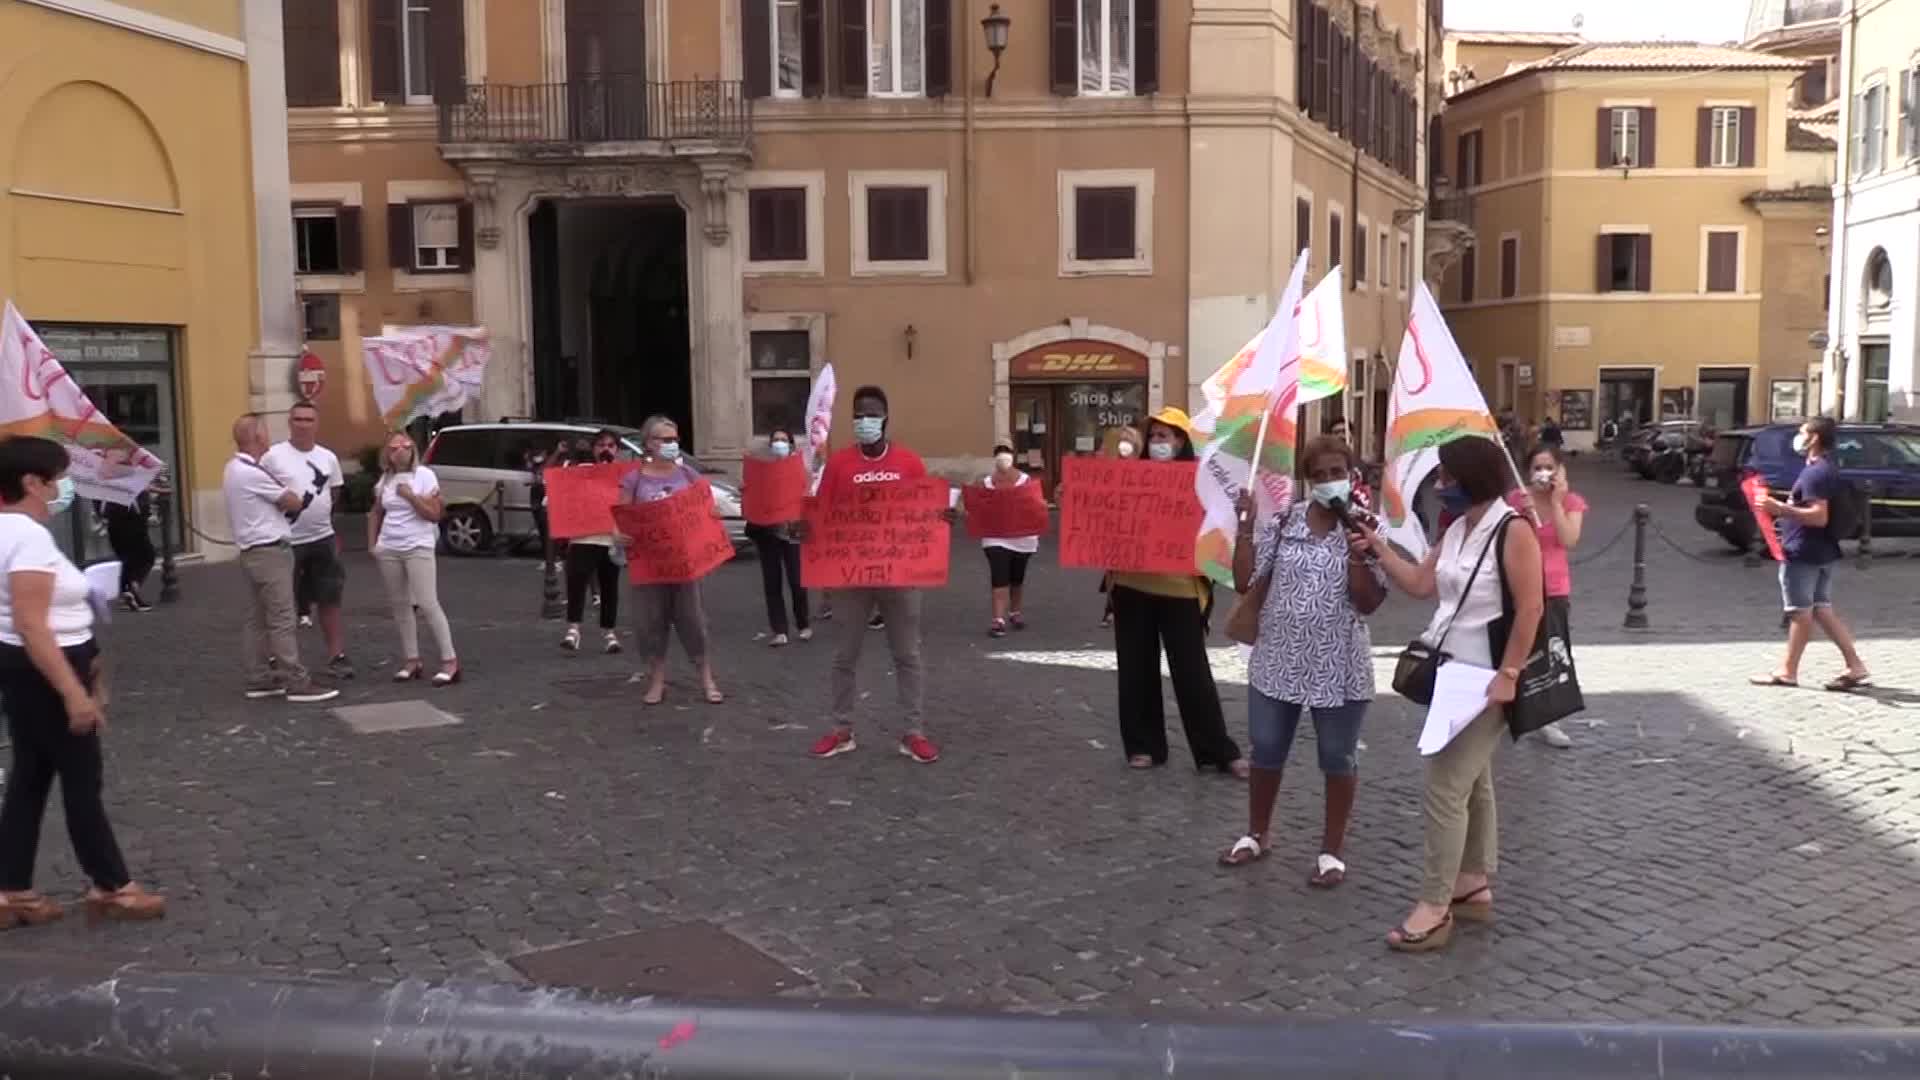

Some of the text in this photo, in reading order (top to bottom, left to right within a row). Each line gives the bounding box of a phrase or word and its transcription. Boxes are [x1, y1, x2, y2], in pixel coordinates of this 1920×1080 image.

[1043, 354, 1119, 371] DHL
[1070, 391, 1123, 407] Shop &
[1098, 410, 1133, 426] Ship
[853, 471, 900, 484] adidas
[841, 564, 893, 583] VITA!
